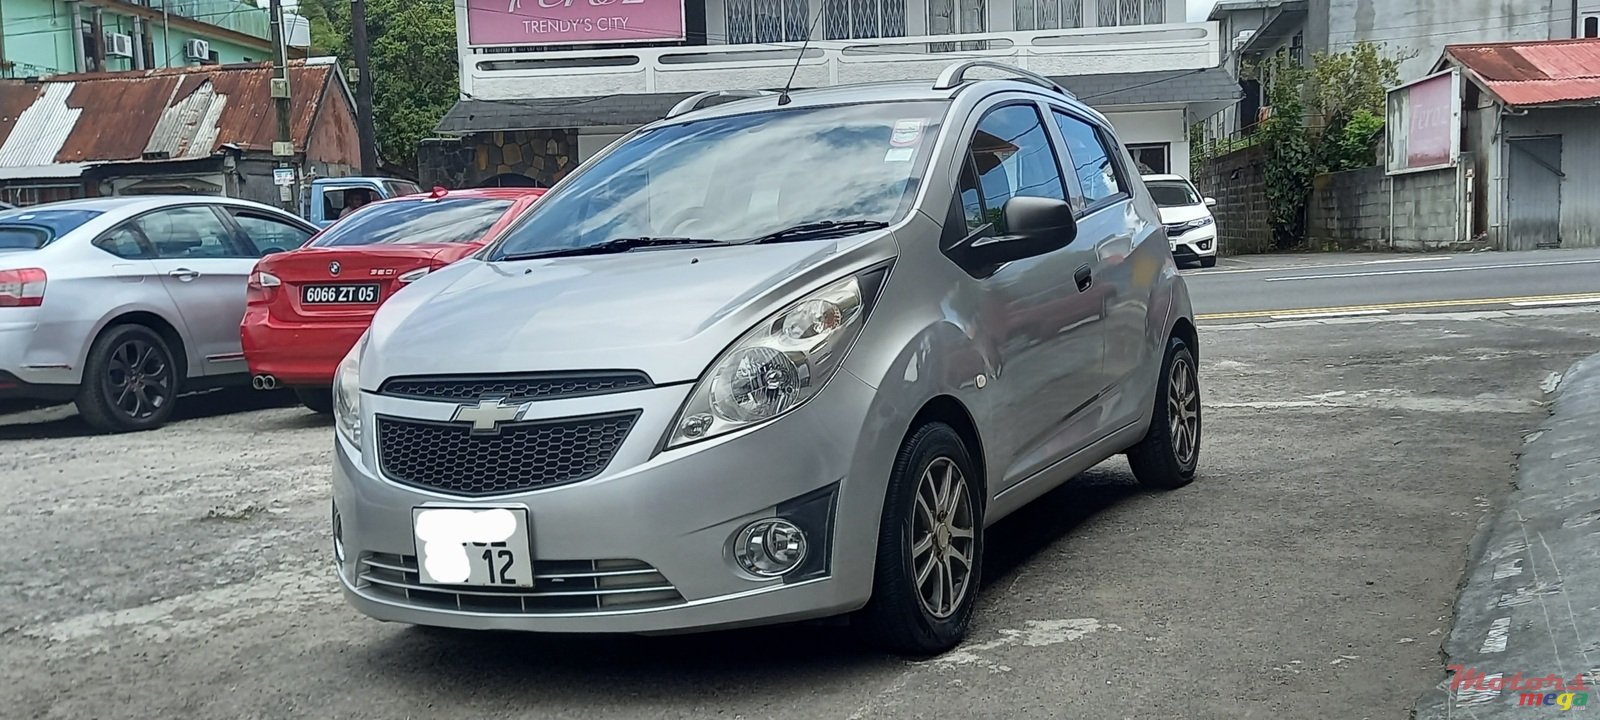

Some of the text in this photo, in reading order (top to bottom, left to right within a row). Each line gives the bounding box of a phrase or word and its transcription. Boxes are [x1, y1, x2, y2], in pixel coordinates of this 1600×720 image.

[522, 17, 629, 33] TRENDY'S CITY
[307, 286, 374, 302] 6066 ZT 05
[482, 549, 517, 584] 12
